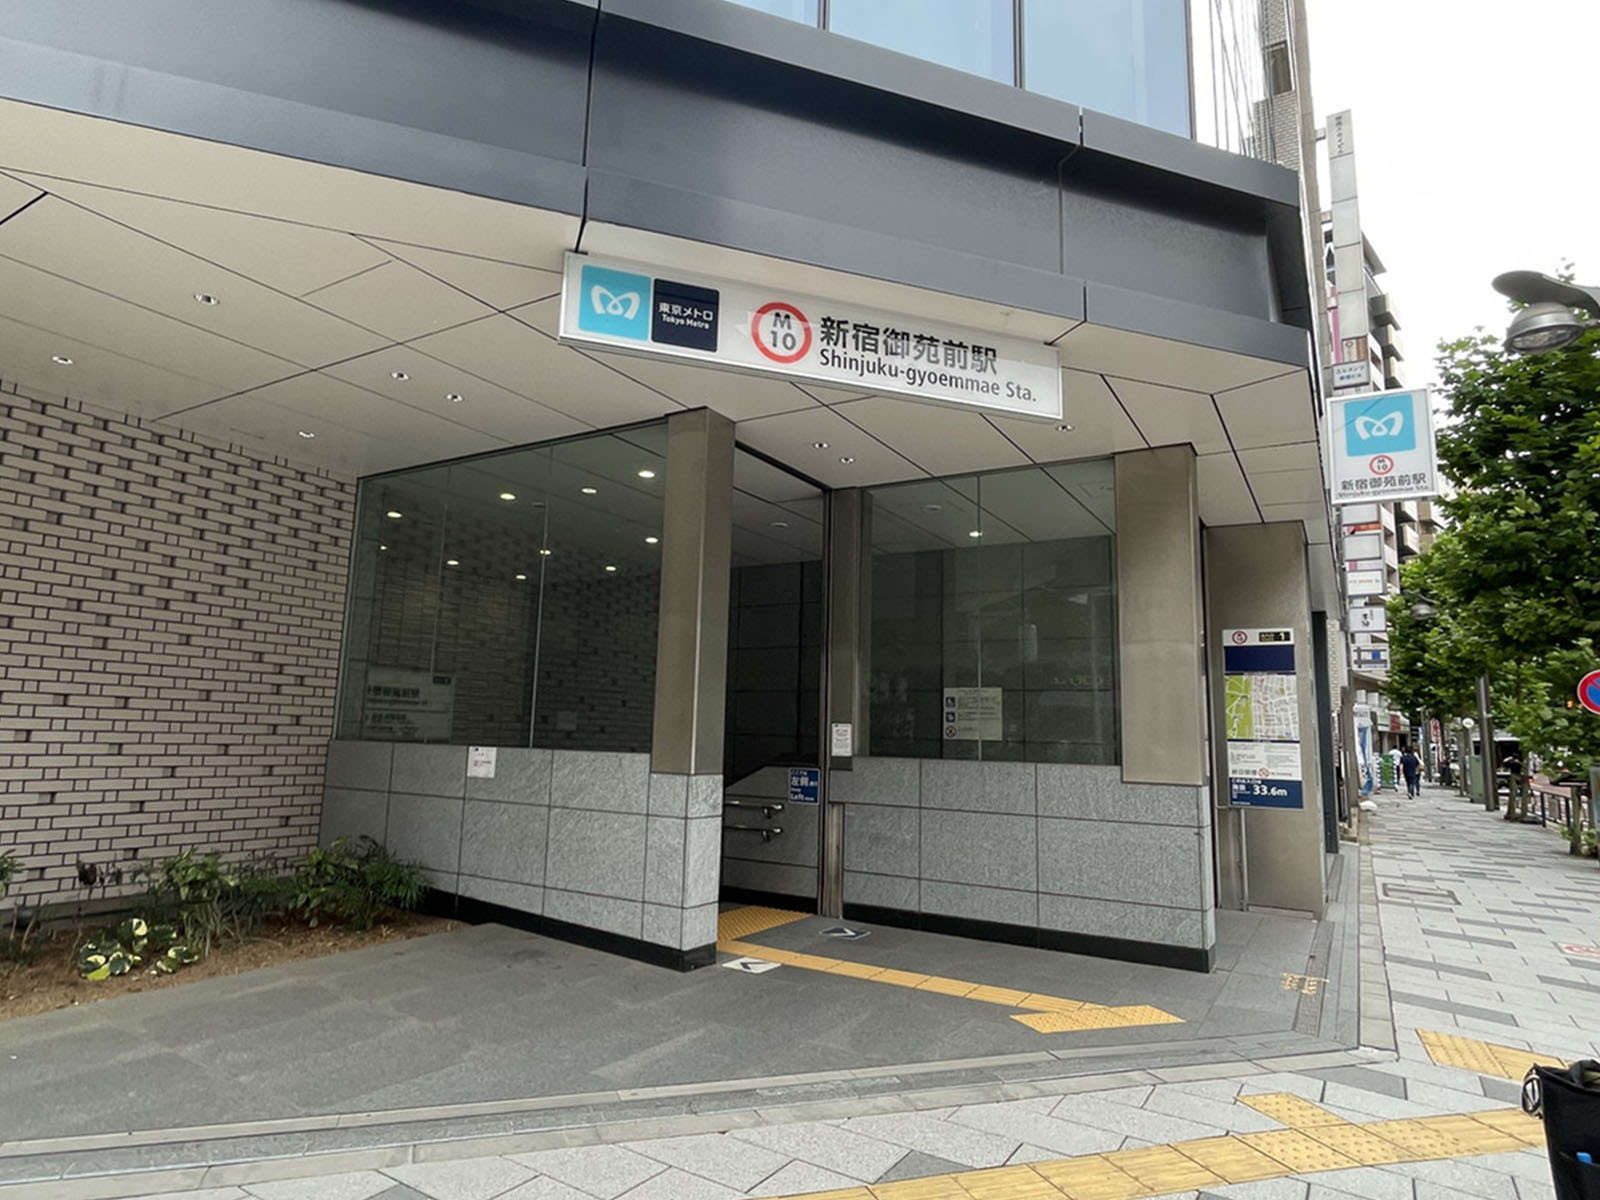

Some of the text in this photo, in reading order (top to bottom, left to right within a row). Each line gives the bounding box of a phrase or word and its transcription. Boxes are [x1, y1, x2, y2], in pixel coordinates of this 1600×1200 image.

[659, 302, 714, 321] 東京メトロ
[661, 313, 710, 330] Tokyo Metro
[772, 312, 792, 331] M
[770, 330, 797, 351] 10
[820, 315, 998, 375] 新宿御苑前駅
[820, 348, 1037, 402] Shinjuku-gyoemmae Sta.
[1341, 473, 1426, 490] 新宿御苑前駅
[1252, 784, 1288, 797] 33.6m
